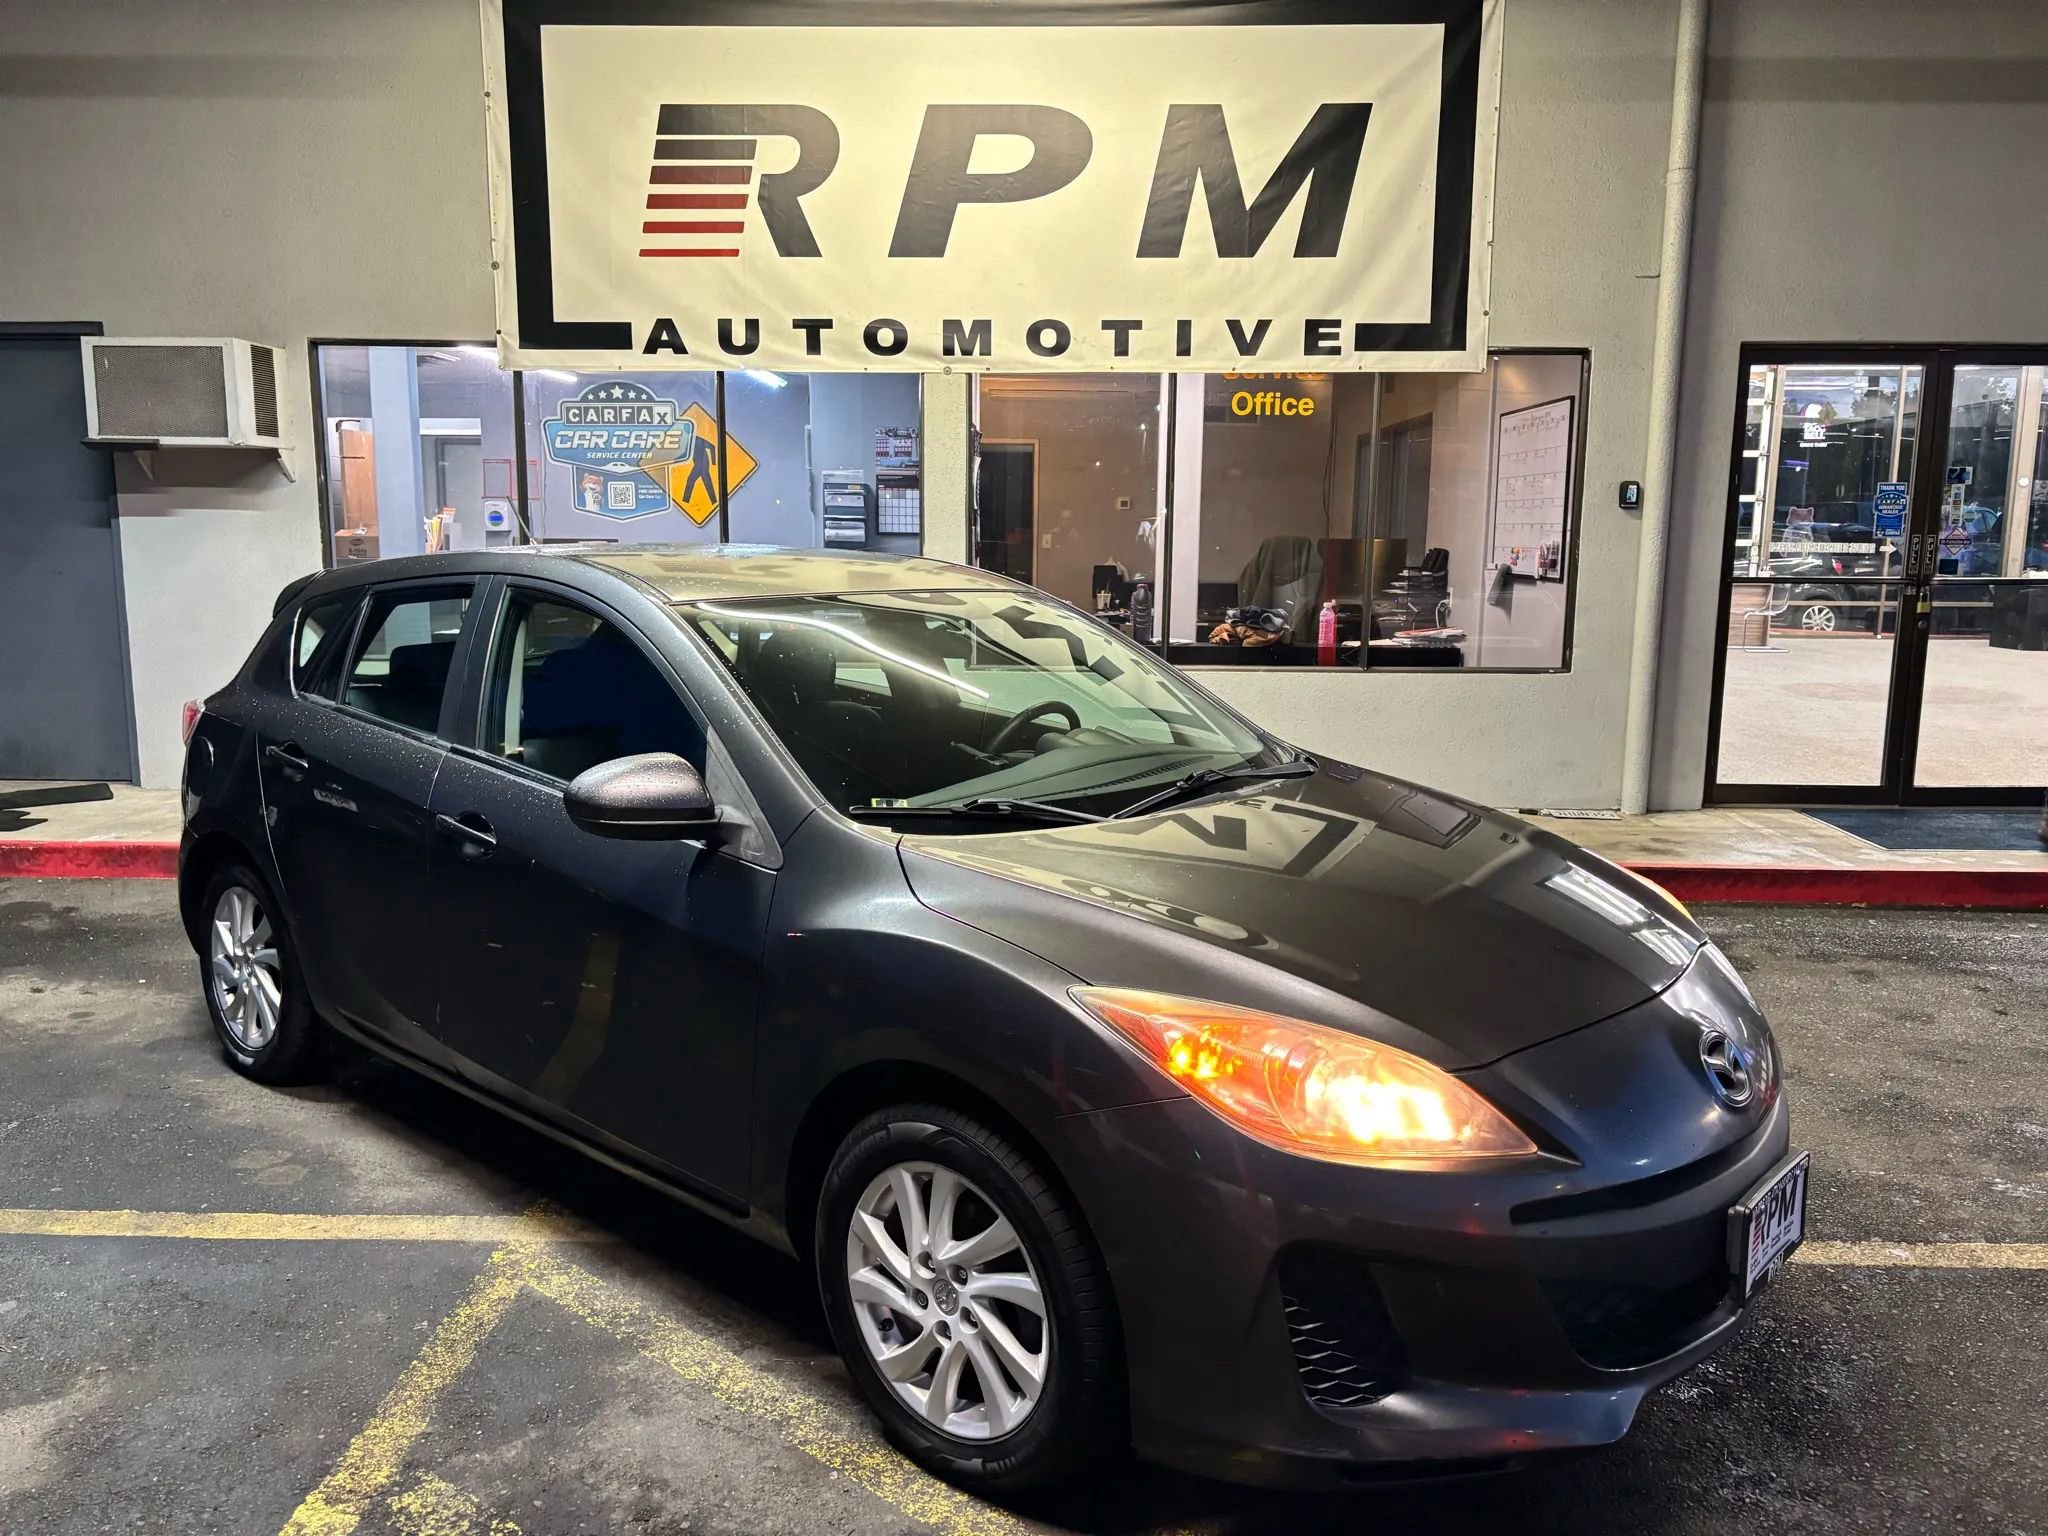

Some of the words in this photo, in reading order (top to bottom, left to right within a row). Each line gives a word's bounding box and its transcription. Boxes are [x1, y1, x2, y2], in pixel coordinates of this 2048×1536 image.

[639, 103, 1373, 258] RPM
[642, 317, 1342, 357] AUTOMOTIVE
[568, 407, 668, 424] CARFAX
[1231, 391, 1315, 416] Office
[555, 430, 609, 449] CAR
[611, 430, 682, 449] CARE
[586, 451, 620, 459] SERVICE
[621, 451, 653, 459] CENTER
[1911, 538, 1919, 563] PULL
[1926, 538, 1934, 563] PULL
[1751, 1173, 1799, 1260] RPM
